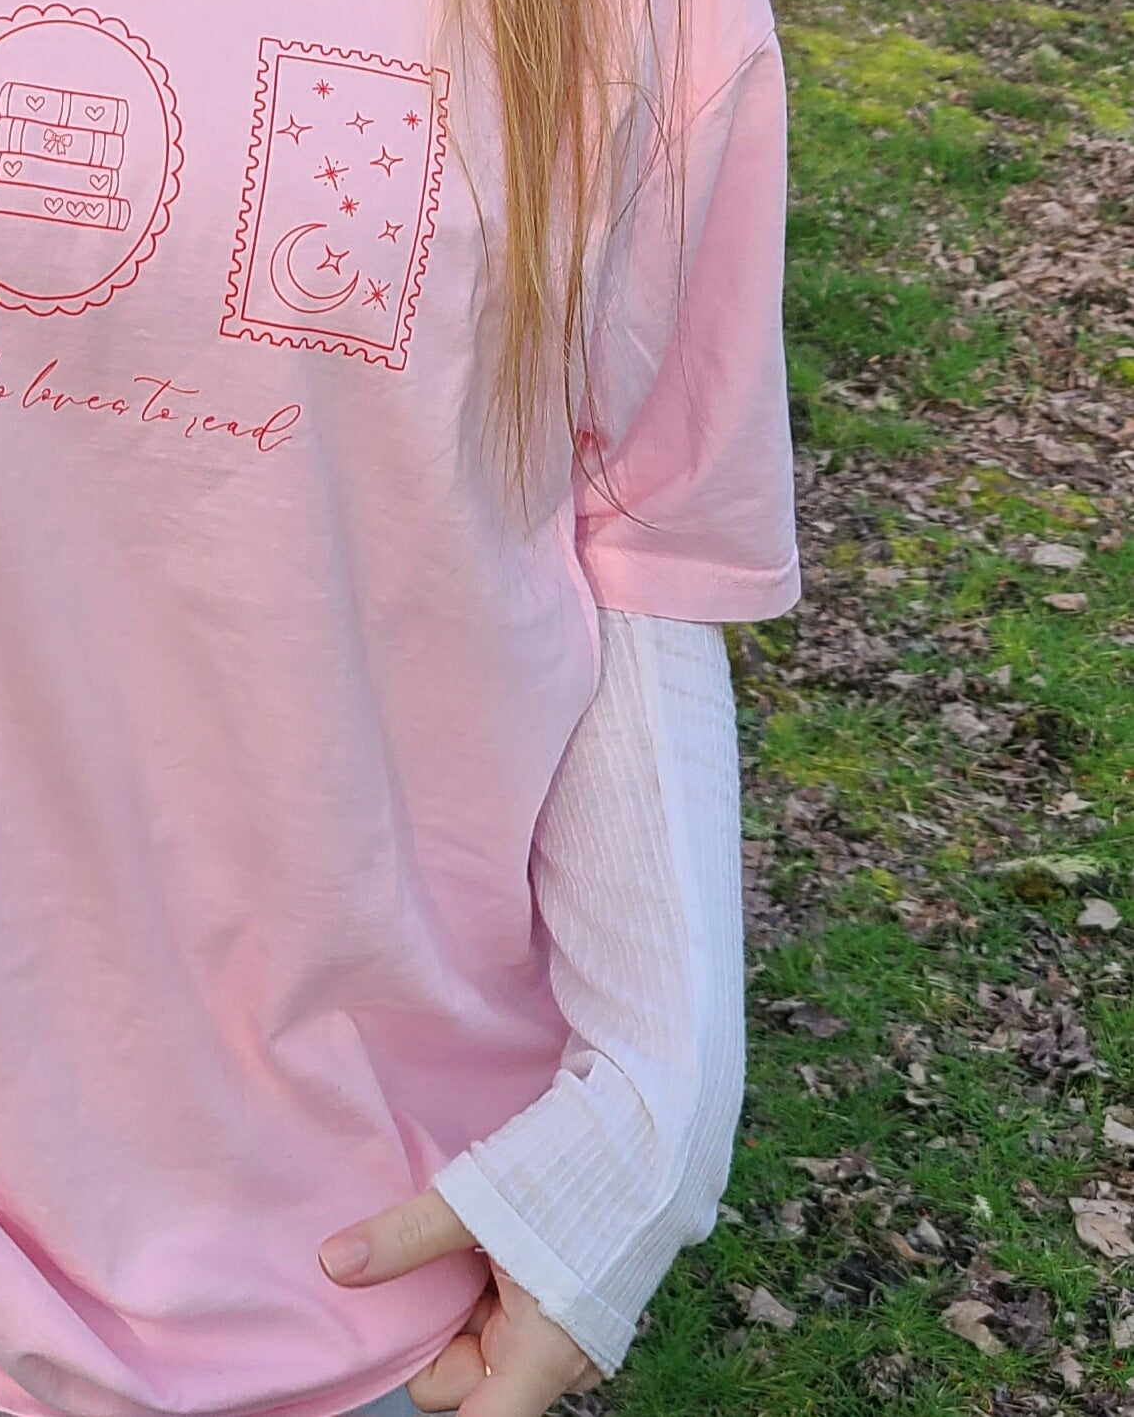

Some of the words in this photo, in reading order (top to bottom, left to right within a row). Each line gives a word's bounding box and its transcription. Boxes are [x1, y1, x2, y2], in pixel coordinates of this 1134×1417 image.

[22, 359, 130, 416] loves
[134, 377, 200, 423] to
[184, 404, 301, 453] read
